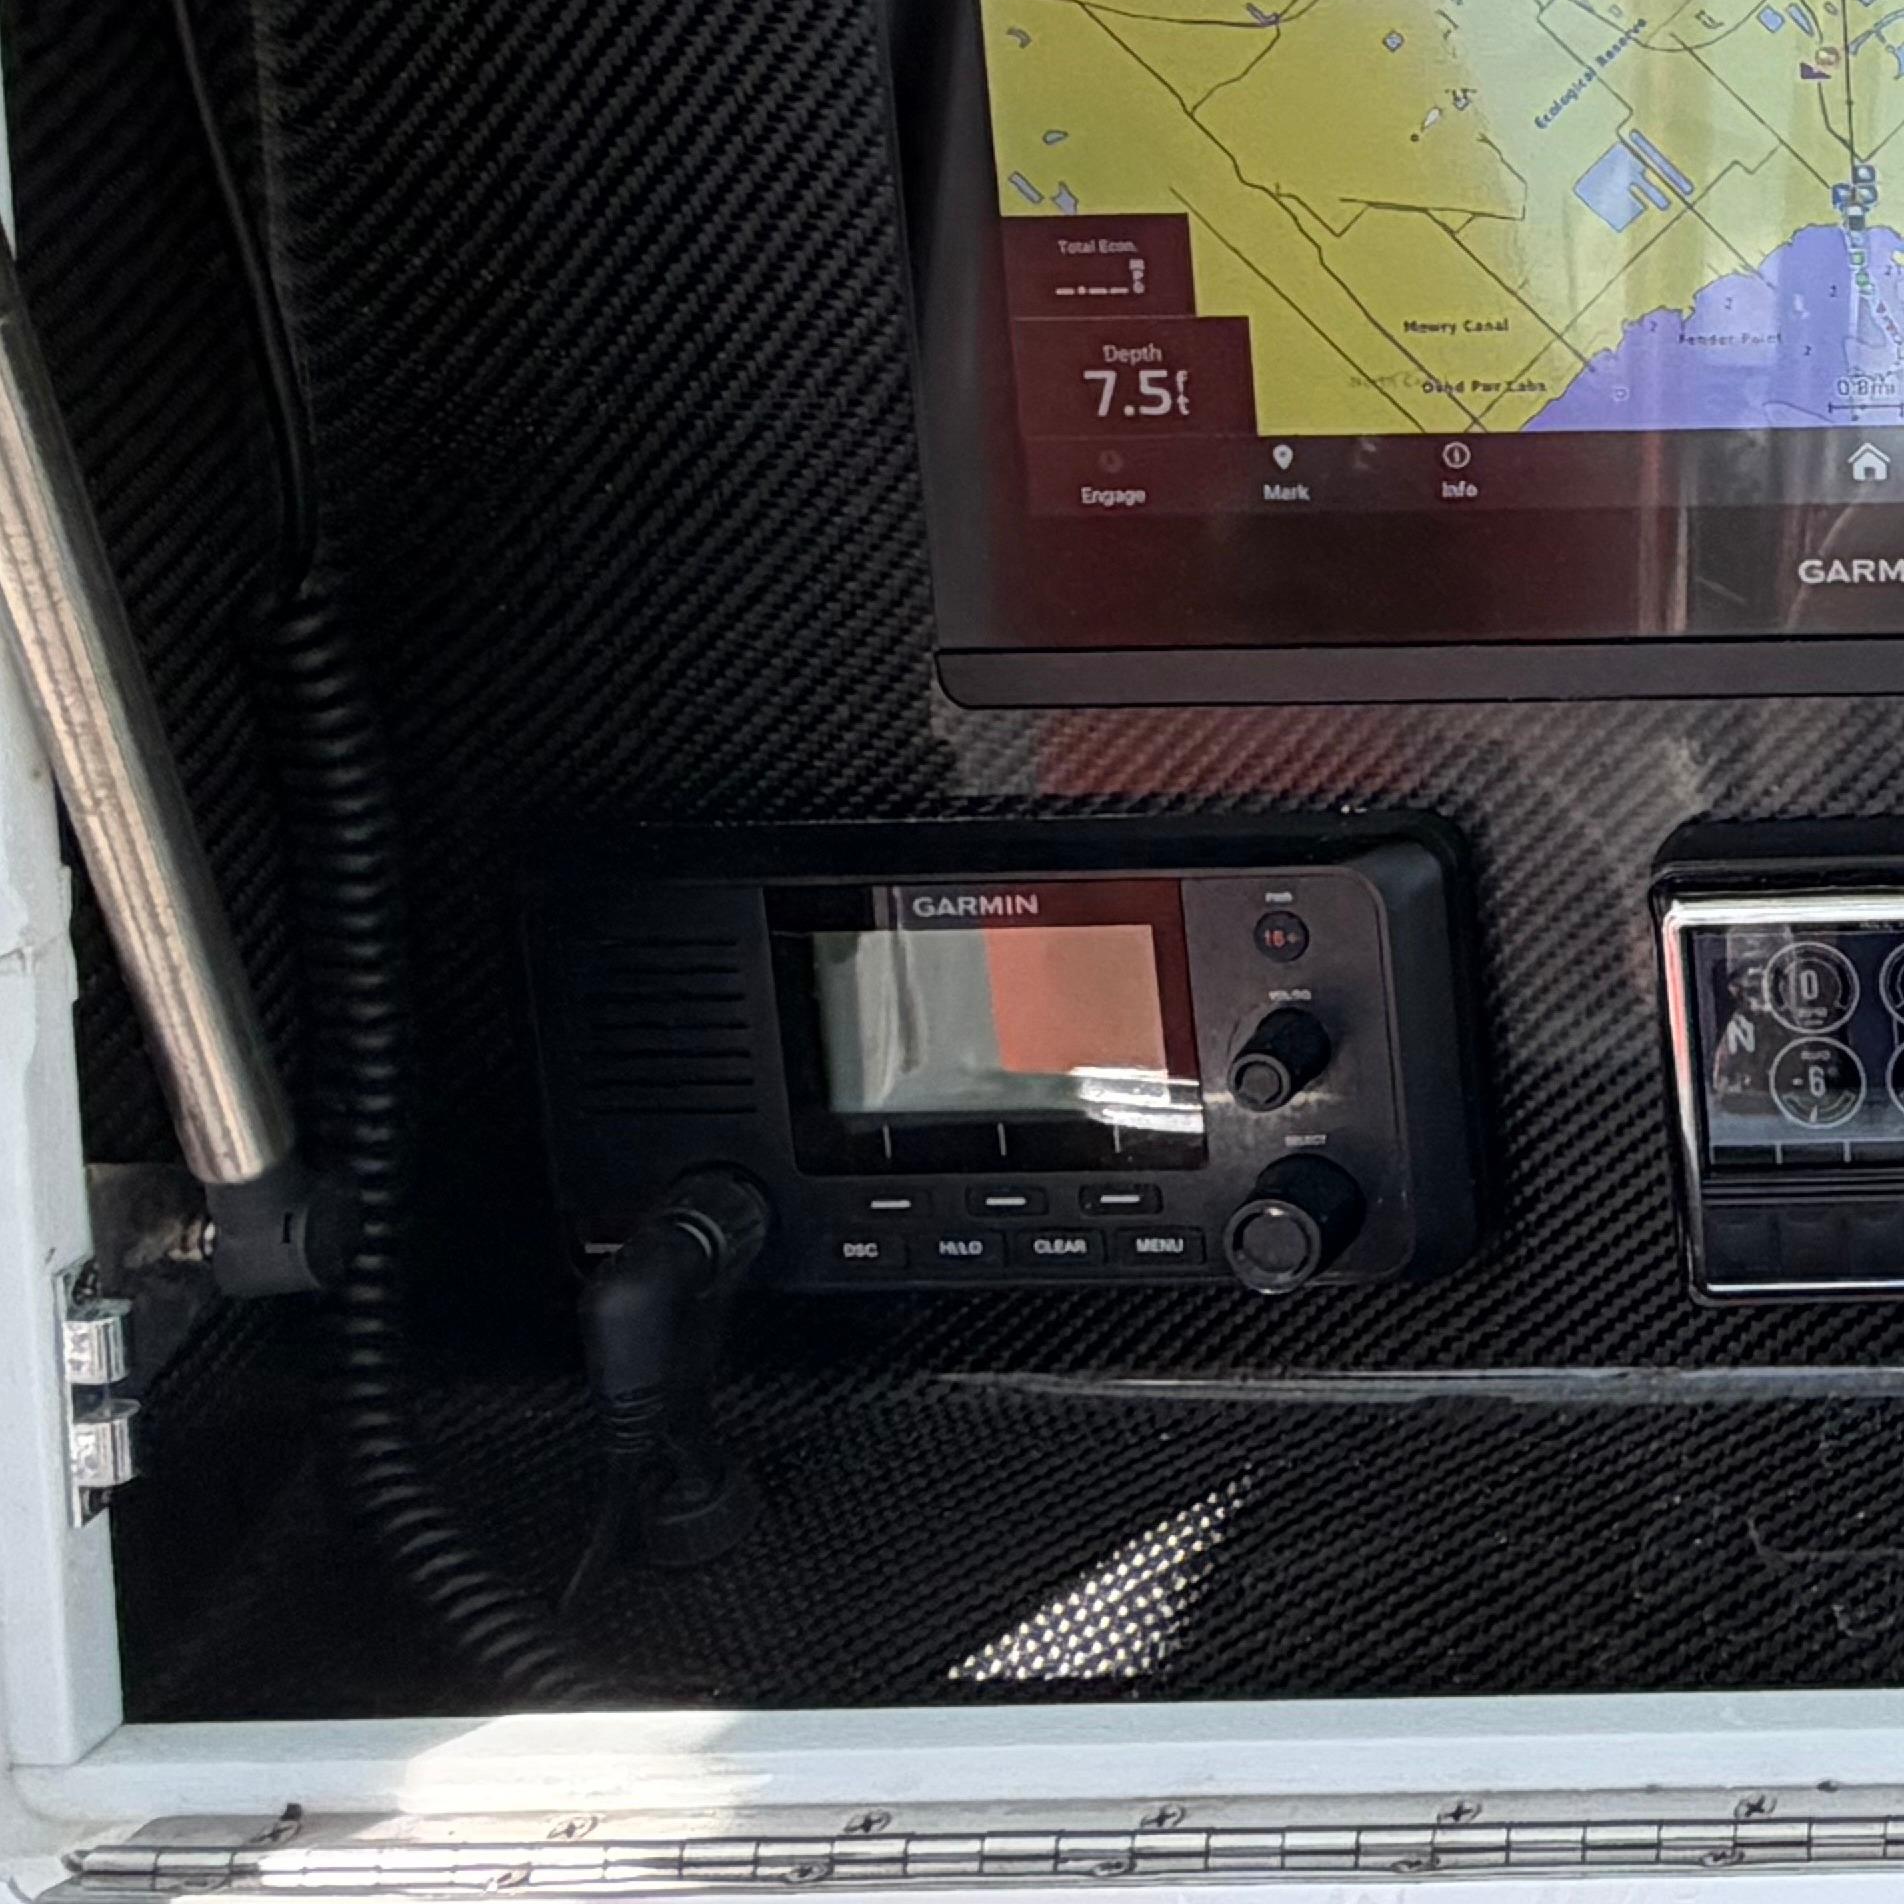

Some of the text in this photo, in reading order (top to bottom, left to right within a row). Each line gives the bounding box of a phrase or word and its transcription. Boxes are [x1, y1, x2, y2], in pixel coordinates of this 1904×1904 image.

[1058, 239, 1096, 254] Total
[1103, 344, 1163, 363] Depth
[1084, 370, 1172, 417] 7.5
[1081, 487, 1146, 507] Engage
[1264, 484, 1311, 502] Mark
[1441, 481, 1478, 498] Info
[912, 895, 1039, 917] GARMIN
[1726, 1014, 1755, 1053] N
[843, 1242, 878, 1259] DSC
[1034, 1238, 1088, 1254] CLEAR
[1136, 1238, 1184, 1254] MENU
